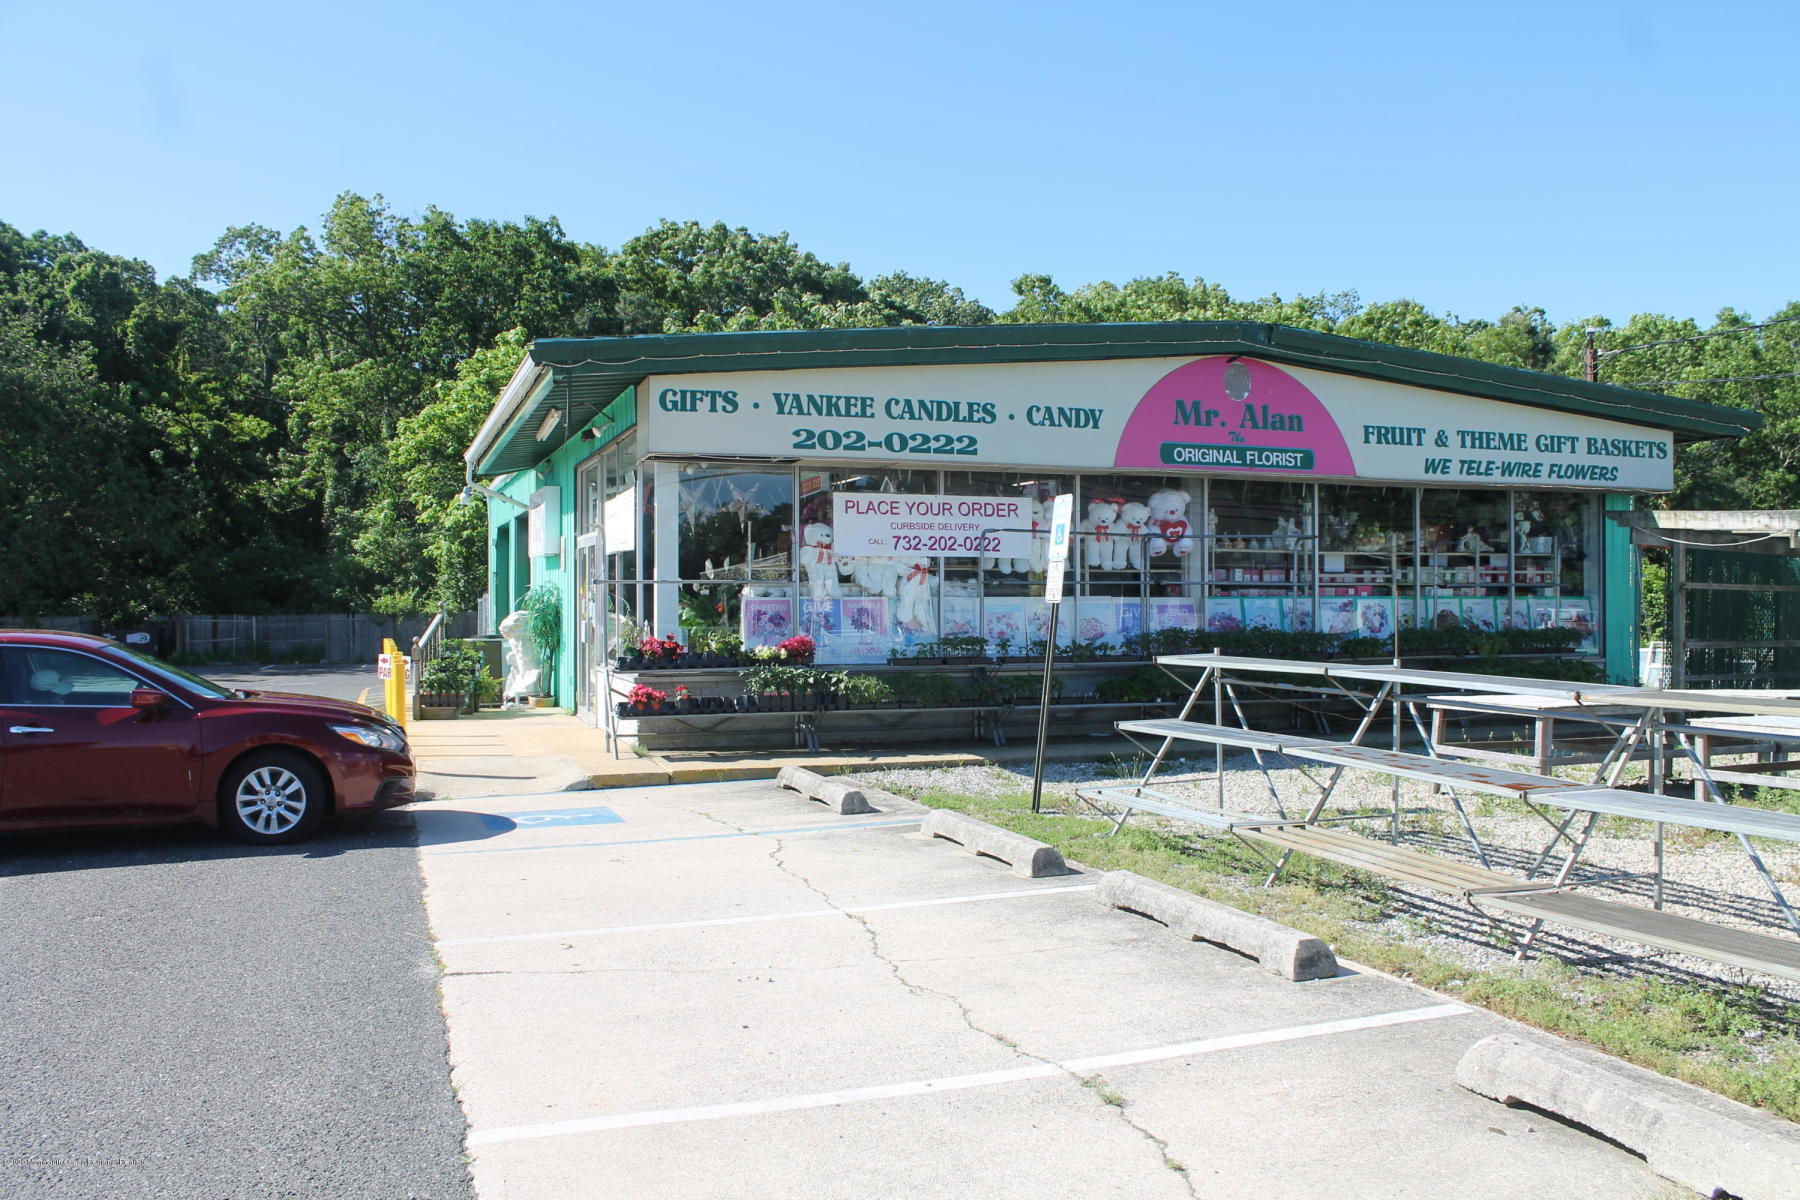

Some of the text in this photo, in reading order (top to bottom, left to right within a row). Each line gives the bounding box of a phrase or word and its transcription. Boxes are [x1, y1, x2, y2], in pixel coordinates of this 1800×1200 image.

[659, 388, 1104, 429] GIFTS YANKEE CANDLES CANDY
[1172, 399, 1305, 432] Mr. Alan
[792, 428, 978, 455] 202-0222
[1362, 424, 1668, 460] FRUIT & THEME GIFT BASKETS
[1173, 447, 1304, 467] ORIGINAL FLORIST
[1424, 458, 1619, 482] WE TELE-WIRE FLOWERS
[844, 500, 1019, 518] PLACE YOUR ORDER
[890, 522, 980, 532] CURBSIDE DELIVERY
[892, 535, 1001, 552] 732-202-0222
[1121, 607, 1141, 617] GIV
